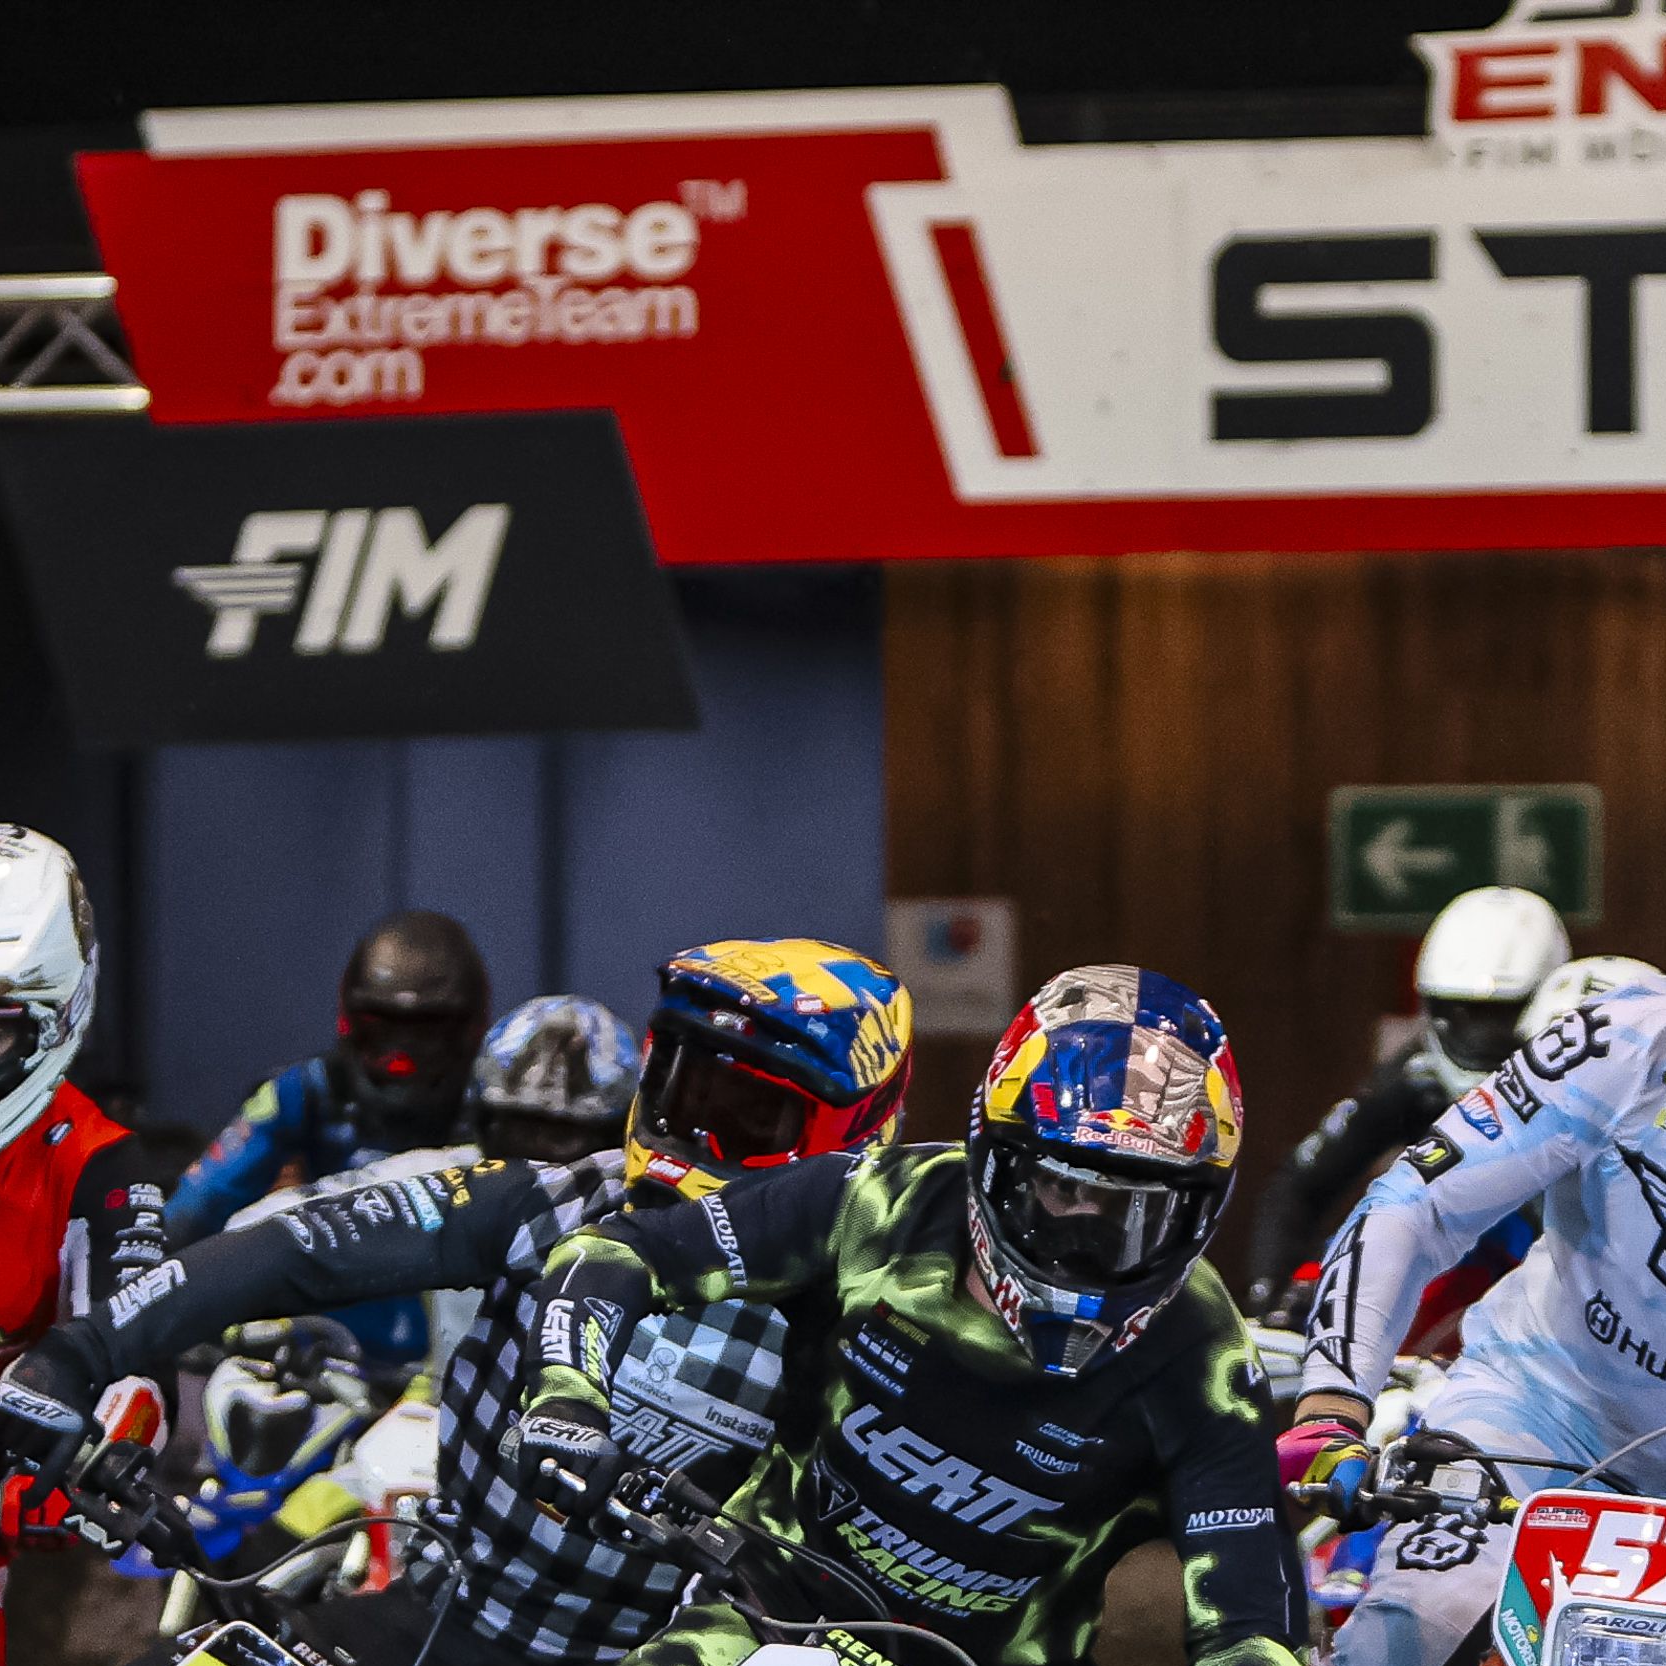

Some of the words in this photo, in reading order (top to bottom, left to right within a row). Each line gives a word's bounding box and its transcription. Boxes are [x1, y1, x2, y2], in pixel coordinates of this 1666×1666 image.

[1465, 135, 1559, 168] FIM
[273, 188, 701, 288] Diverse
[271, 275, 699, 352] ExtremeTeam
[269, 348, 423, 406] .com
[171, 505, 511, 657] FIM
[1075, 1127, 1117, 1146] Red
[1119, 1134, 1162, 1155] Bull
[108, 1258, 187, 1330] LEATT
[841, 1402, 1066, 1534] LEATT
[1015, 1439, 1081, 1473] TRIUMPH
[1528, 1514, 1591, 1525] ENDURO
[1536, 1506, 1586, 1517] SUPER
[835, 1521, 1020, 1612] RACING
[850, 1505, 1043, 1598] TRIUMPH
[920, 1598, 972, 1618] TEAM
